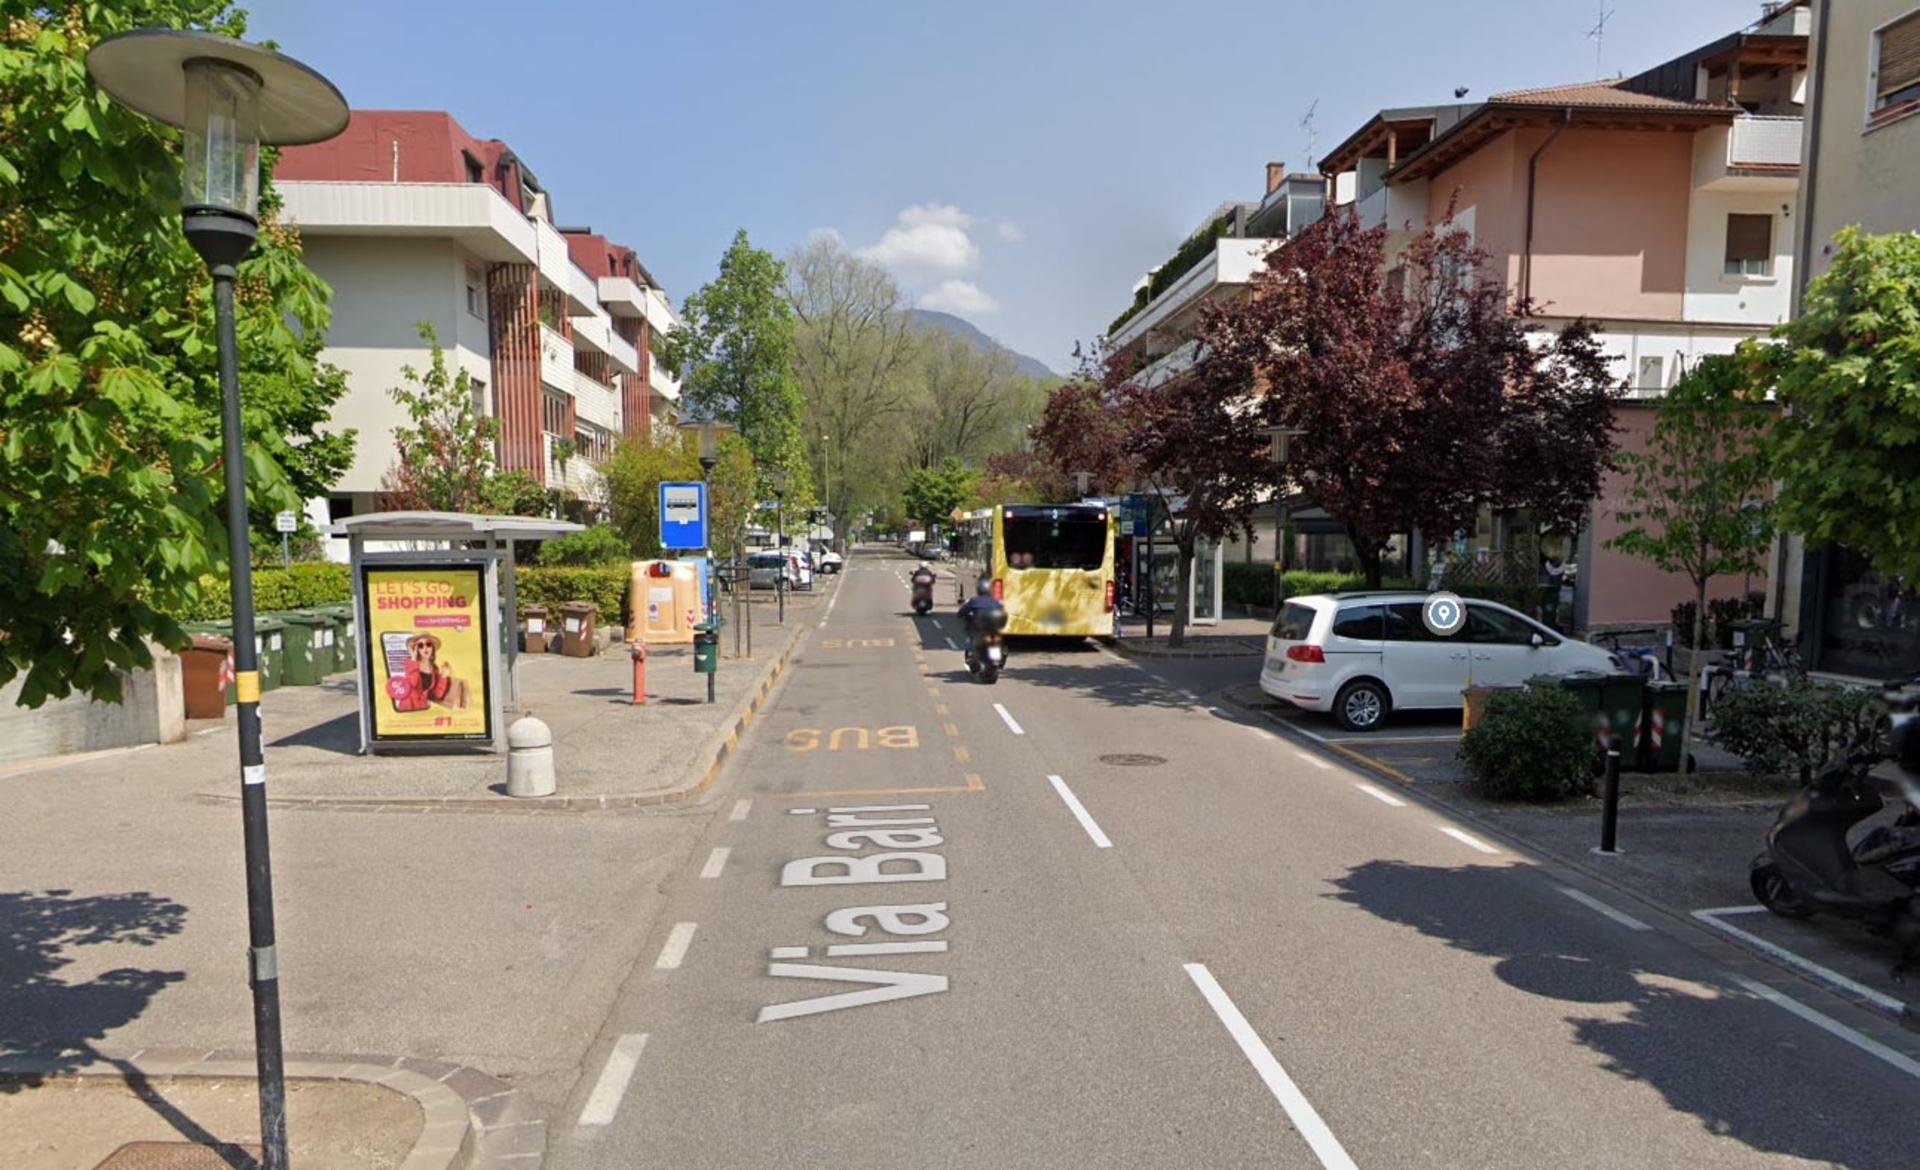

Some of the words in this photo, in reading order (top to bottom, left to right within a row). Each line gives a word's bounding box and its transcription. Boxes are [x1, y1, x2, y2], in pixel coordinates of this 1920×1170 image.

[376, 580, 421, 594] LET'S
[426, 580, 452, 594] GO
[377, 595, 467, 609] SHOPPING
[433, 716, 453, 728] #1
[784, 725, 920, 752] BUS
